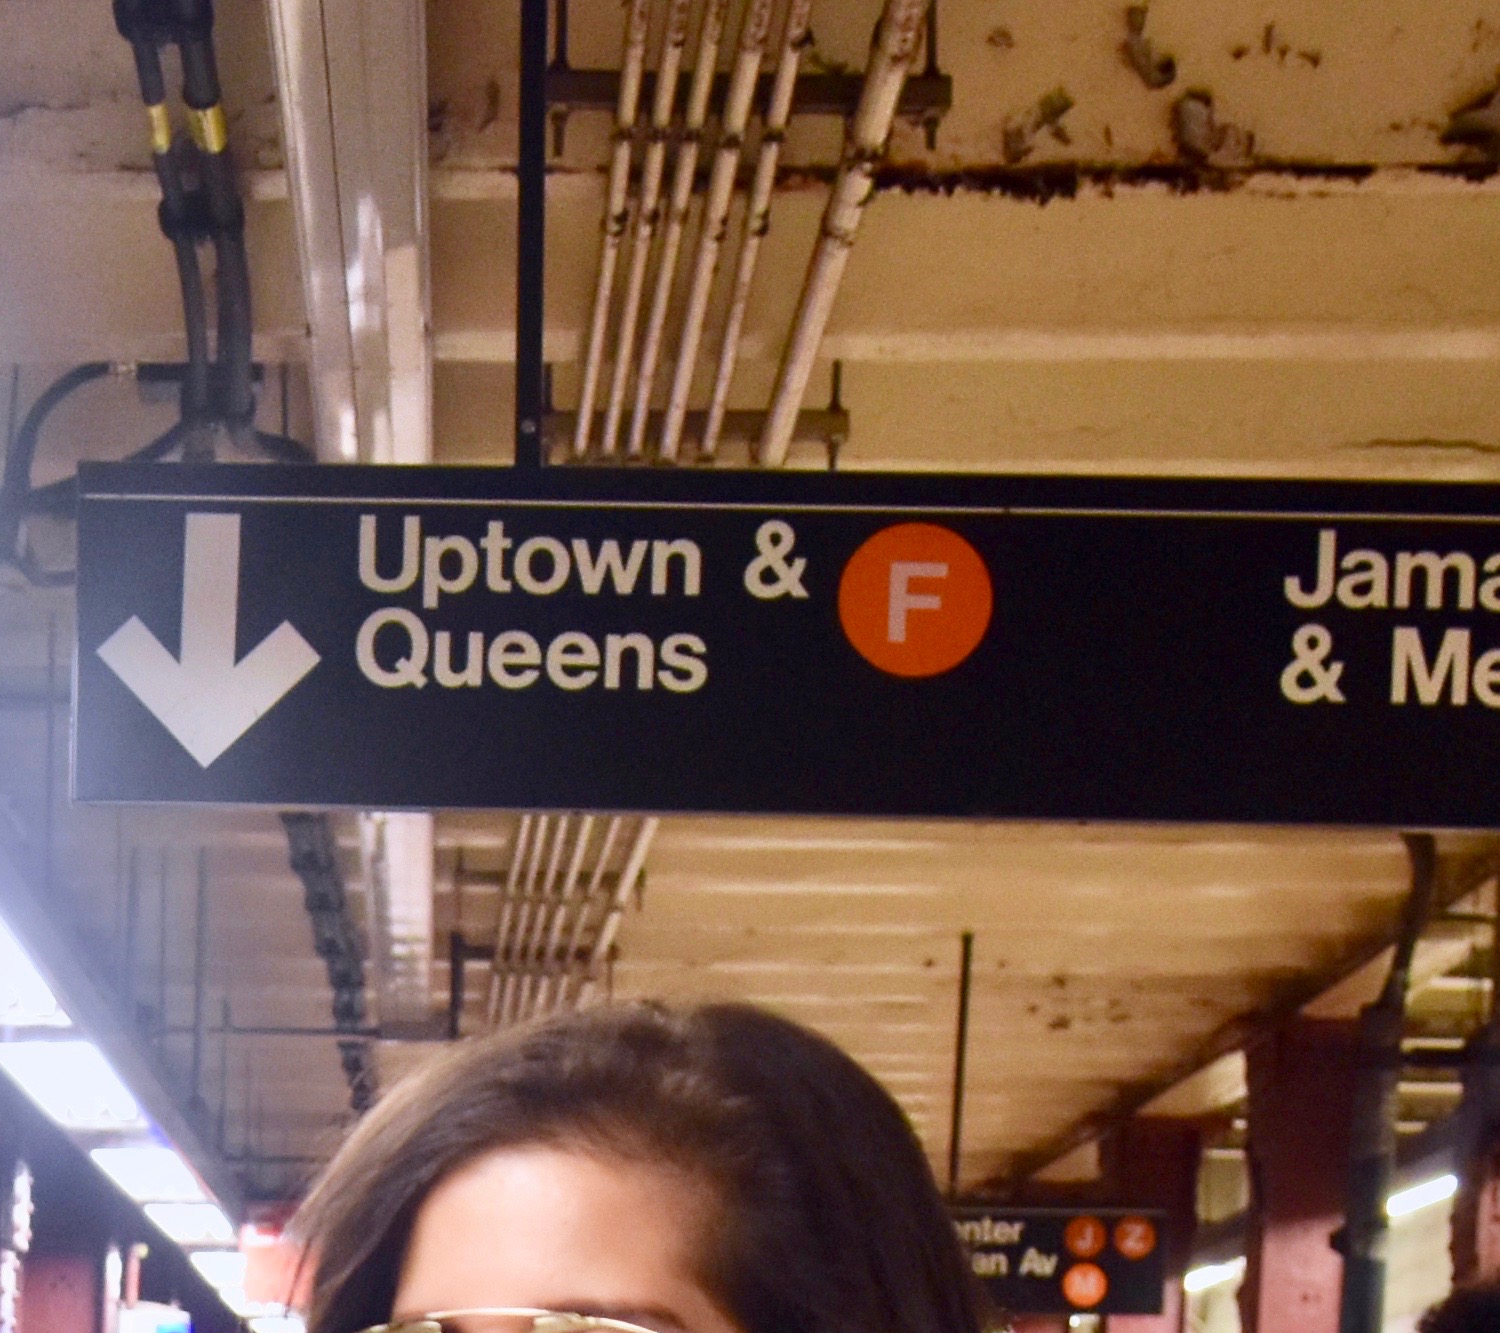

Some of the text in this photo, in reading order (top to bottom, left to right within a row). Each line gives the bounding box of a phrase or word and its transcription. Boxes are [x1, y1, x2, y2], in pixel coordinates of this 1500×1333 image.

[357, 515, 809, 608] Uptown &
[887, 561, 948, 643] F
[355, 606, 708, 692] Queens
[1280, 623, 1346, 703] &
[954, 1217, 1024, 1245] nter
